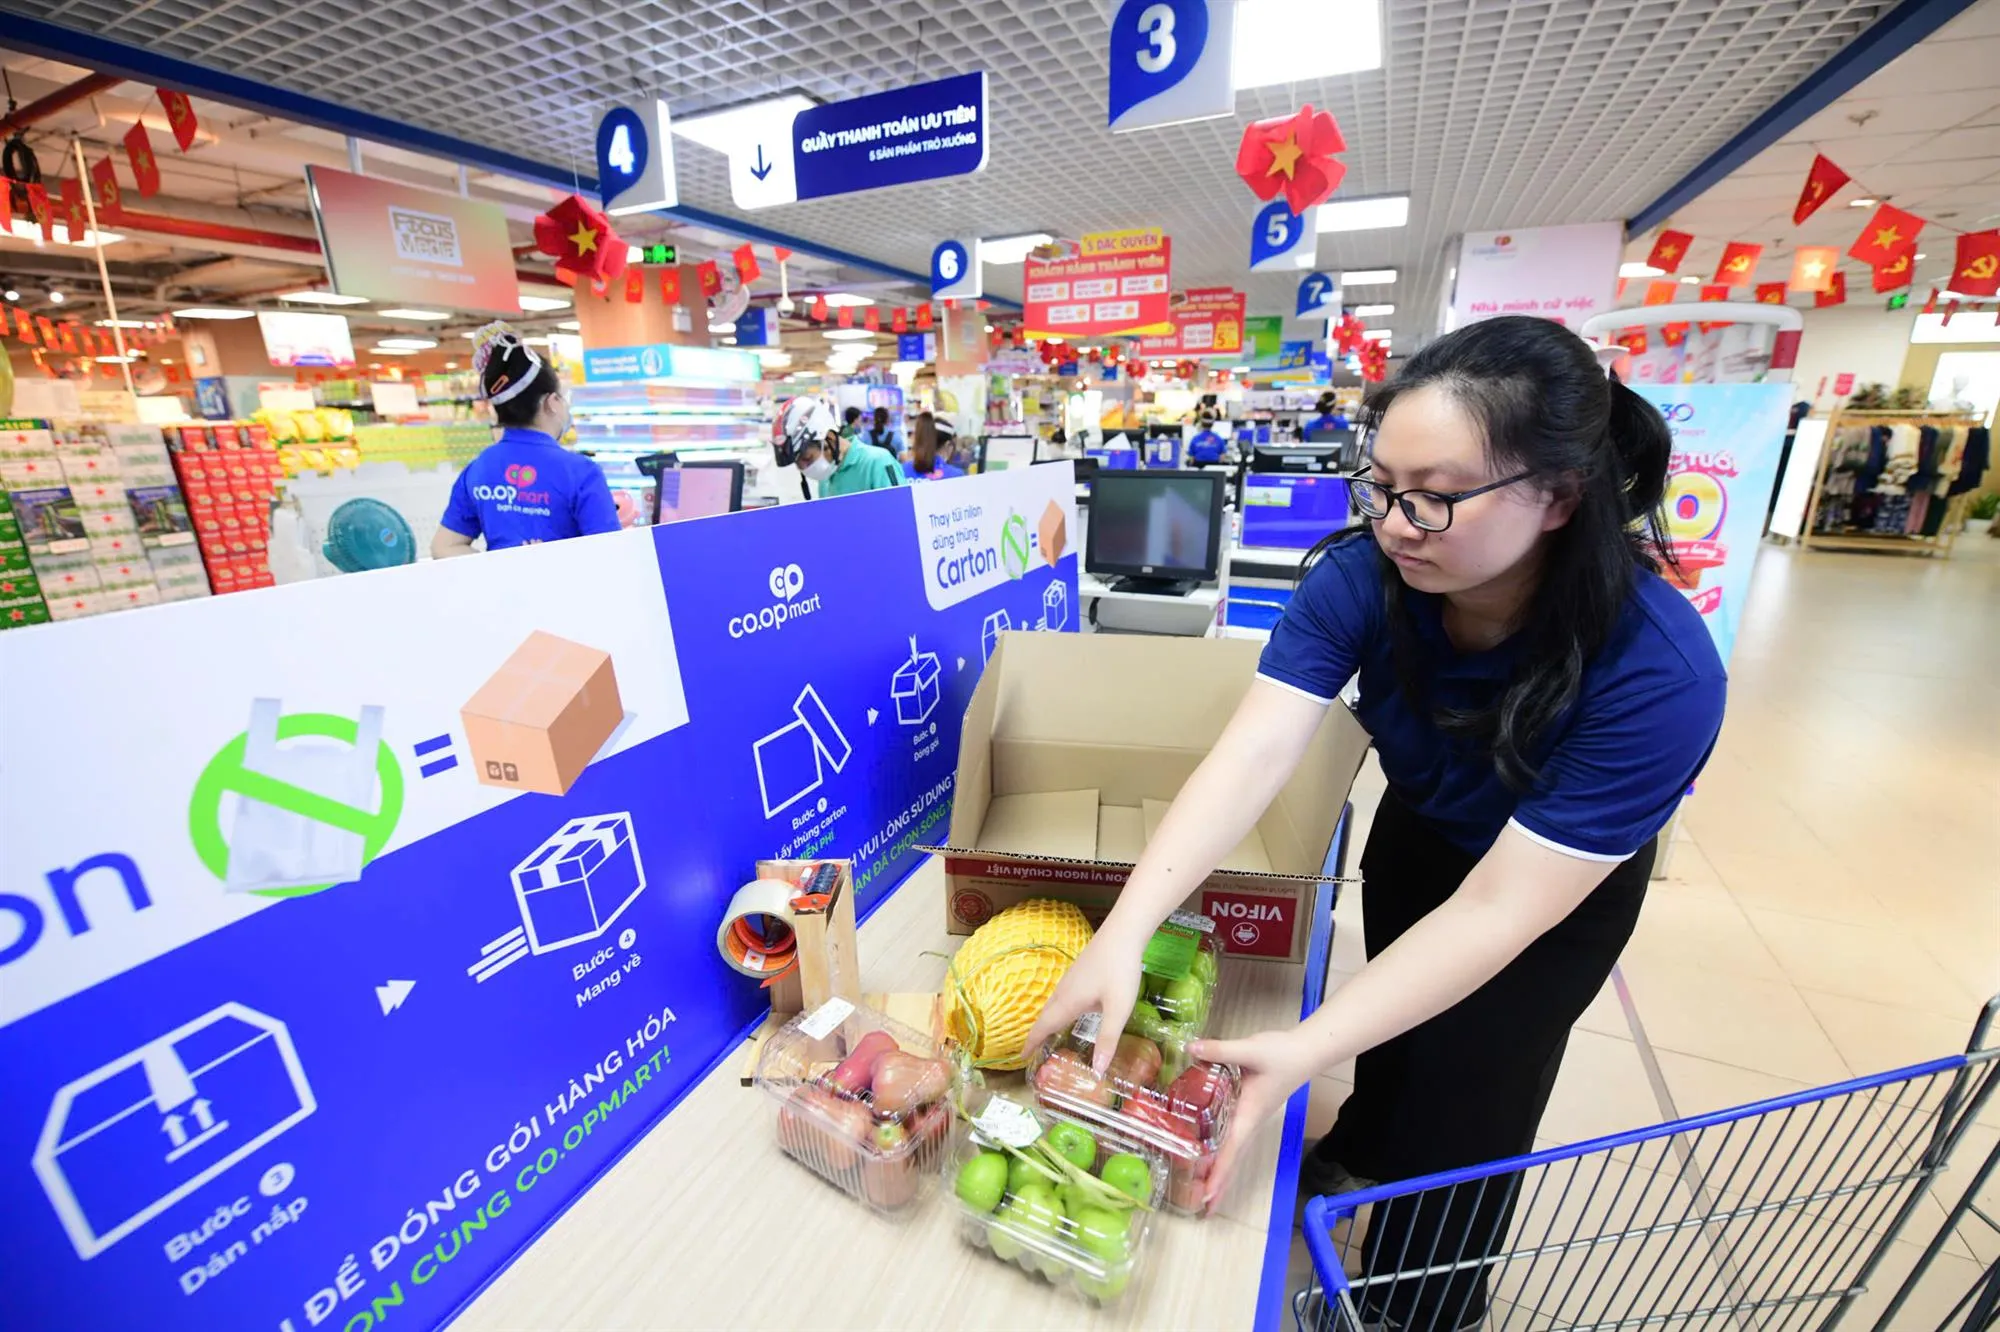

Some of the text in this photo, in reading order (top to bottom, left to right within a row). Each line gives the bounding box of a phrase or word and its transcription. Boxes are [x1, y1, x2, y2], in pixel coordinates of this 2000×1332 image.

[1136, 4, 1177, 73] 3
[837, 124, 881, 146] THANH
[882, 116, 919, 139] TOÁN
[921, 112, 942, 131] ƯU
[608, 124, 635, 174] 4
[1266, 213, 1290, 245] 5
[939, 249, 959, 279] 6
[1308, 281, 1324, 304] 7
[1470, 300, 1499, 313] Nhà
[929, 505, 982, 529] Thay túi nilon
[932, 527, 979, 550] dùng thùng
[937, 547, 997, 589] Carton
[775, 805, 847, 861] Lấy thùng carton
[792, 808, 816, 830] Bước
[858, 834, 880, 861] VUI
[880, 810, 910, 845] LÒNG
[925, 776, 952, 807] DỤNG
[795, 842, 819, 861] IỄN
[853, 868, 872, 895] ẠN
[873, 851, 889, 877] ĐÃ
[1013, 867, 1050, 880] CHUẨN
[1055, 869, 1089, 881] NGON
[1211, 901, 1283, 922] VIFON
[572, 946, 616, 982] Bước
[576, 953, 641, 1009] Mang về
[303, 1007, 677, 1327] ĐỂ ĐÓNG GÓI HÀNG HÓA
[411, 1190, 512, 1285] CÙNG
[515, 1045, 674, 1192] CO.OPMART!
[164, 1195, 252, 1263] Bước
[178, 1196, 309, 1297] Dán nắp
